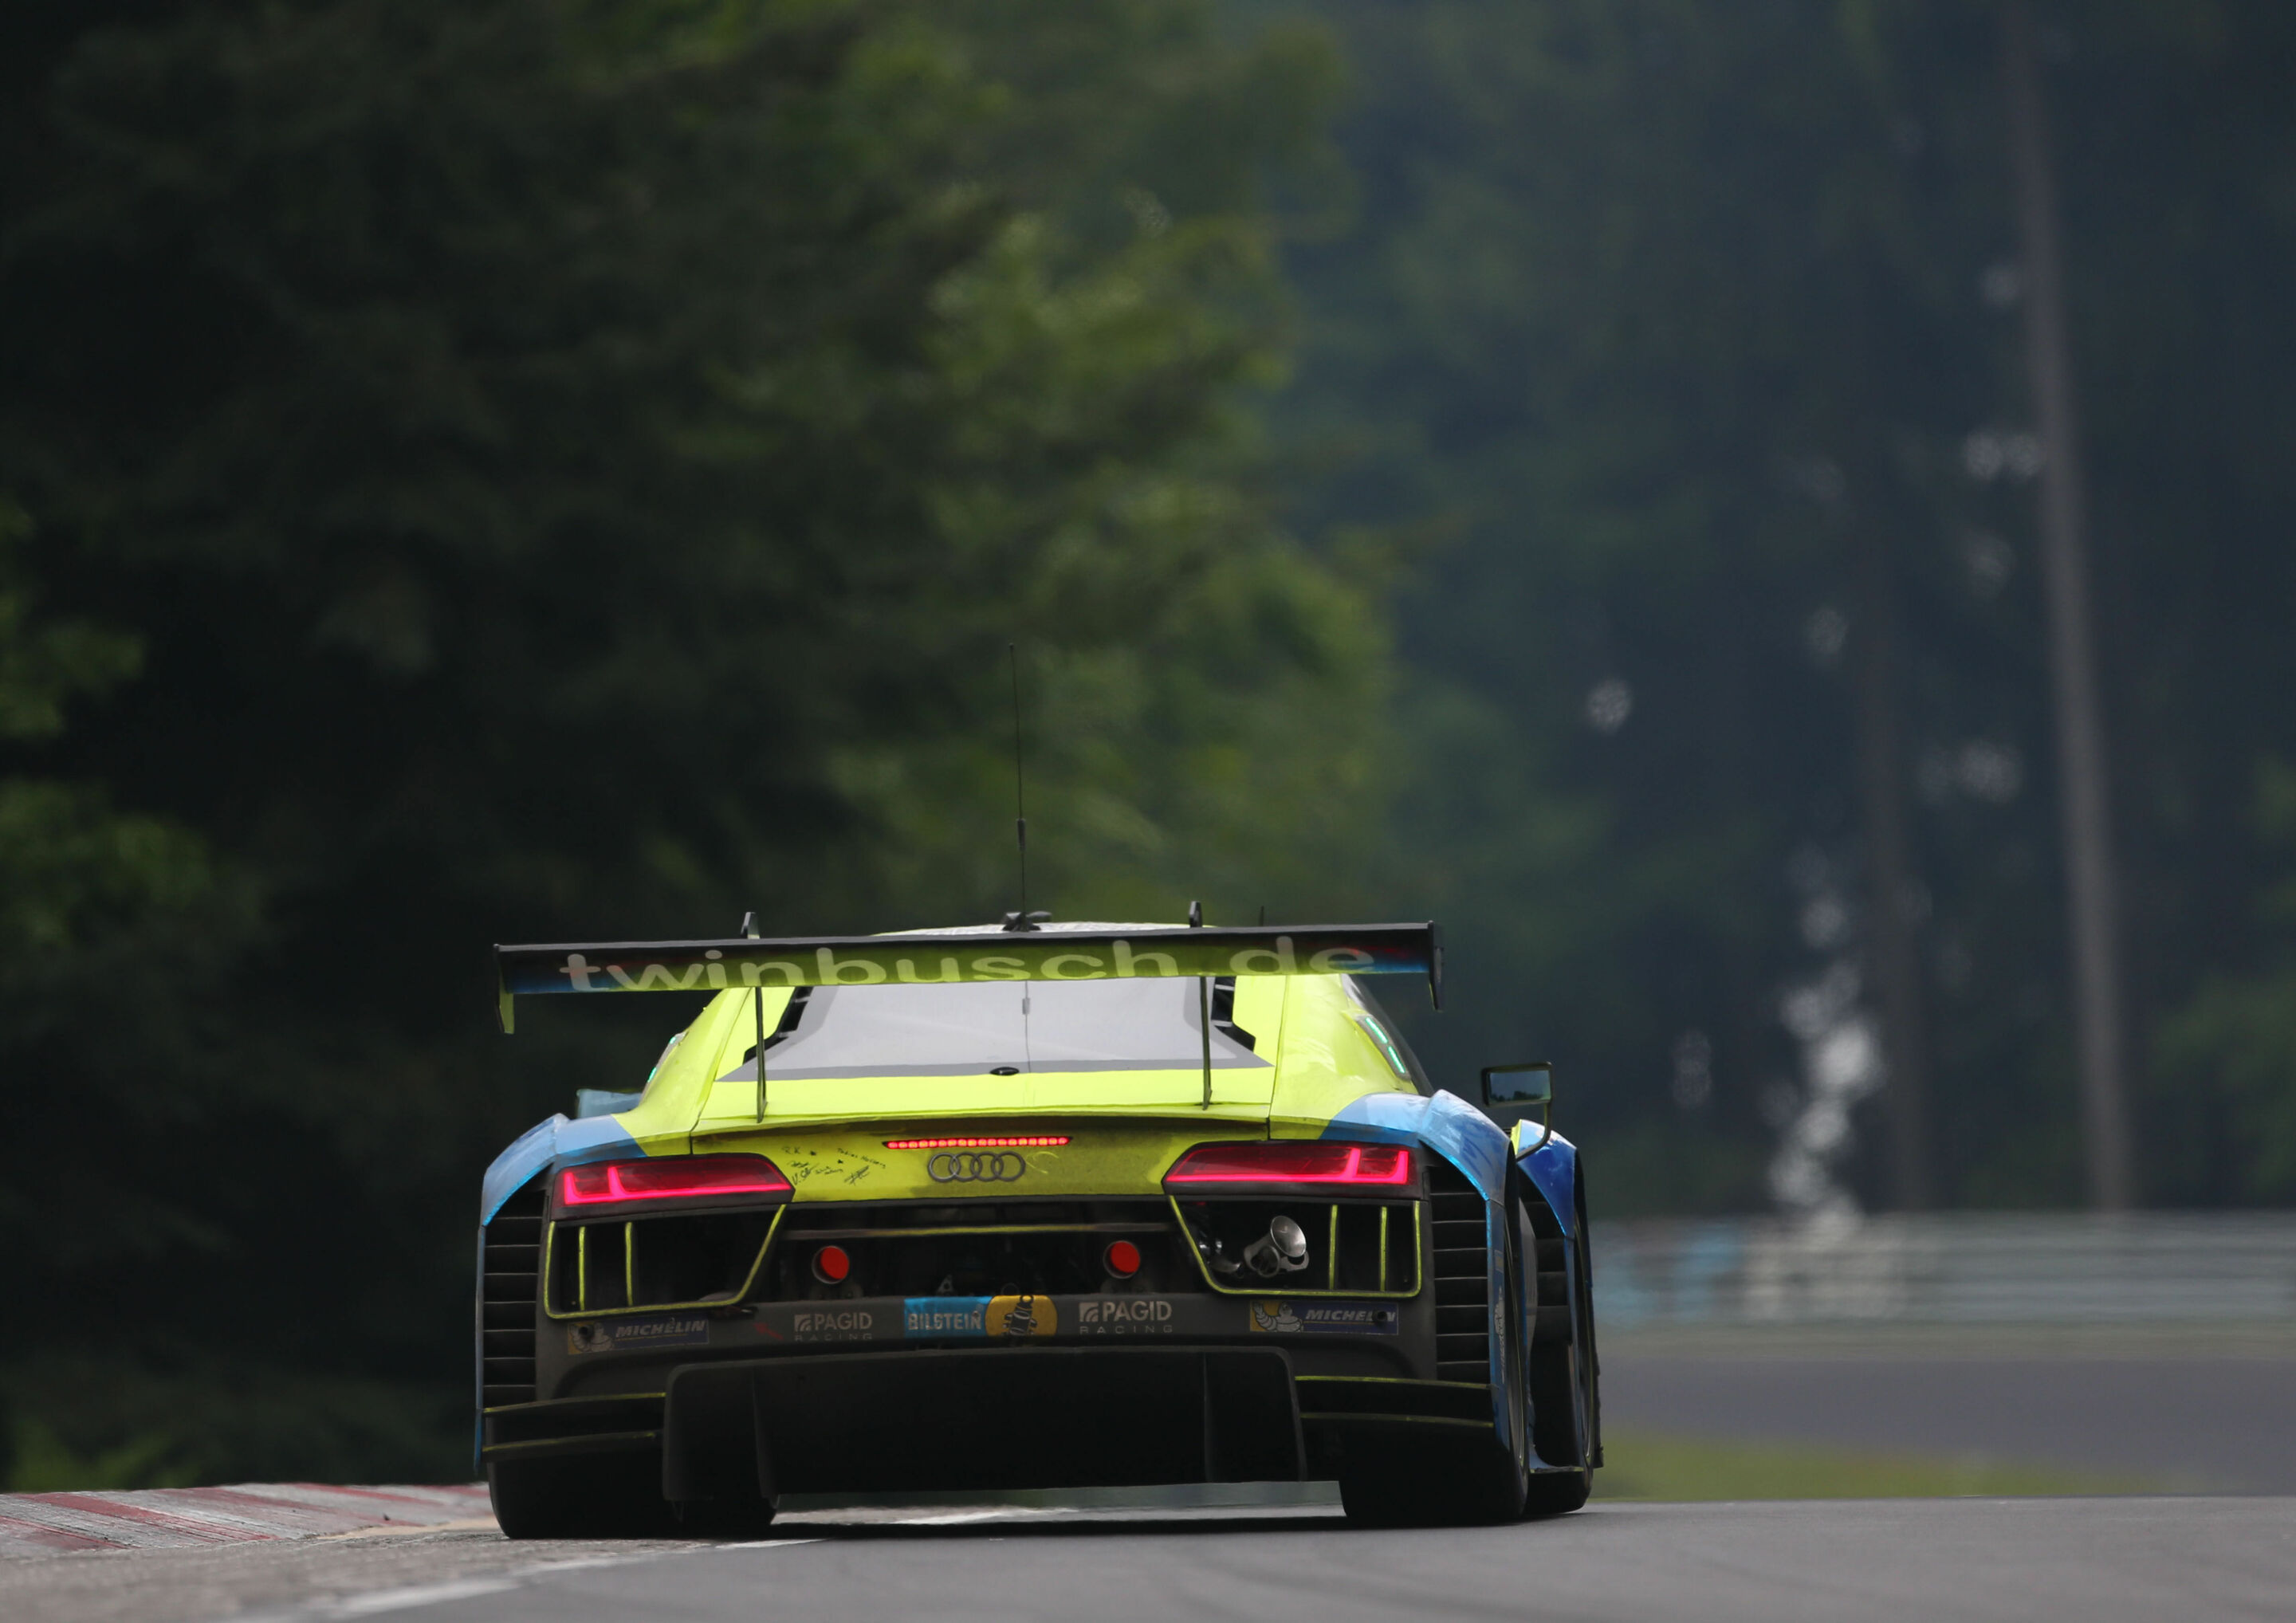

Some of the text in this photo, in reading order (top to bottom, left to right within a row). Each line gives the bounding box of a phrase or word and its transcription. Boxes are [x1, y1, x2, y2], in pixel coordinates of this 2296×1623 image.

[1103, 1300, 1173, 1322] PAGID
[1305, 1309, 1396, 1322] MICHELN
[615, 1320, 707, 1338] MICHELIN
[814, 1313, 873, 1331] PAGID
[907, 1311, 981, 1330] BILSTEIN
[795, 1332, 873, 1342] RACING
[1079, 1325, 1173, 1335] RACING
